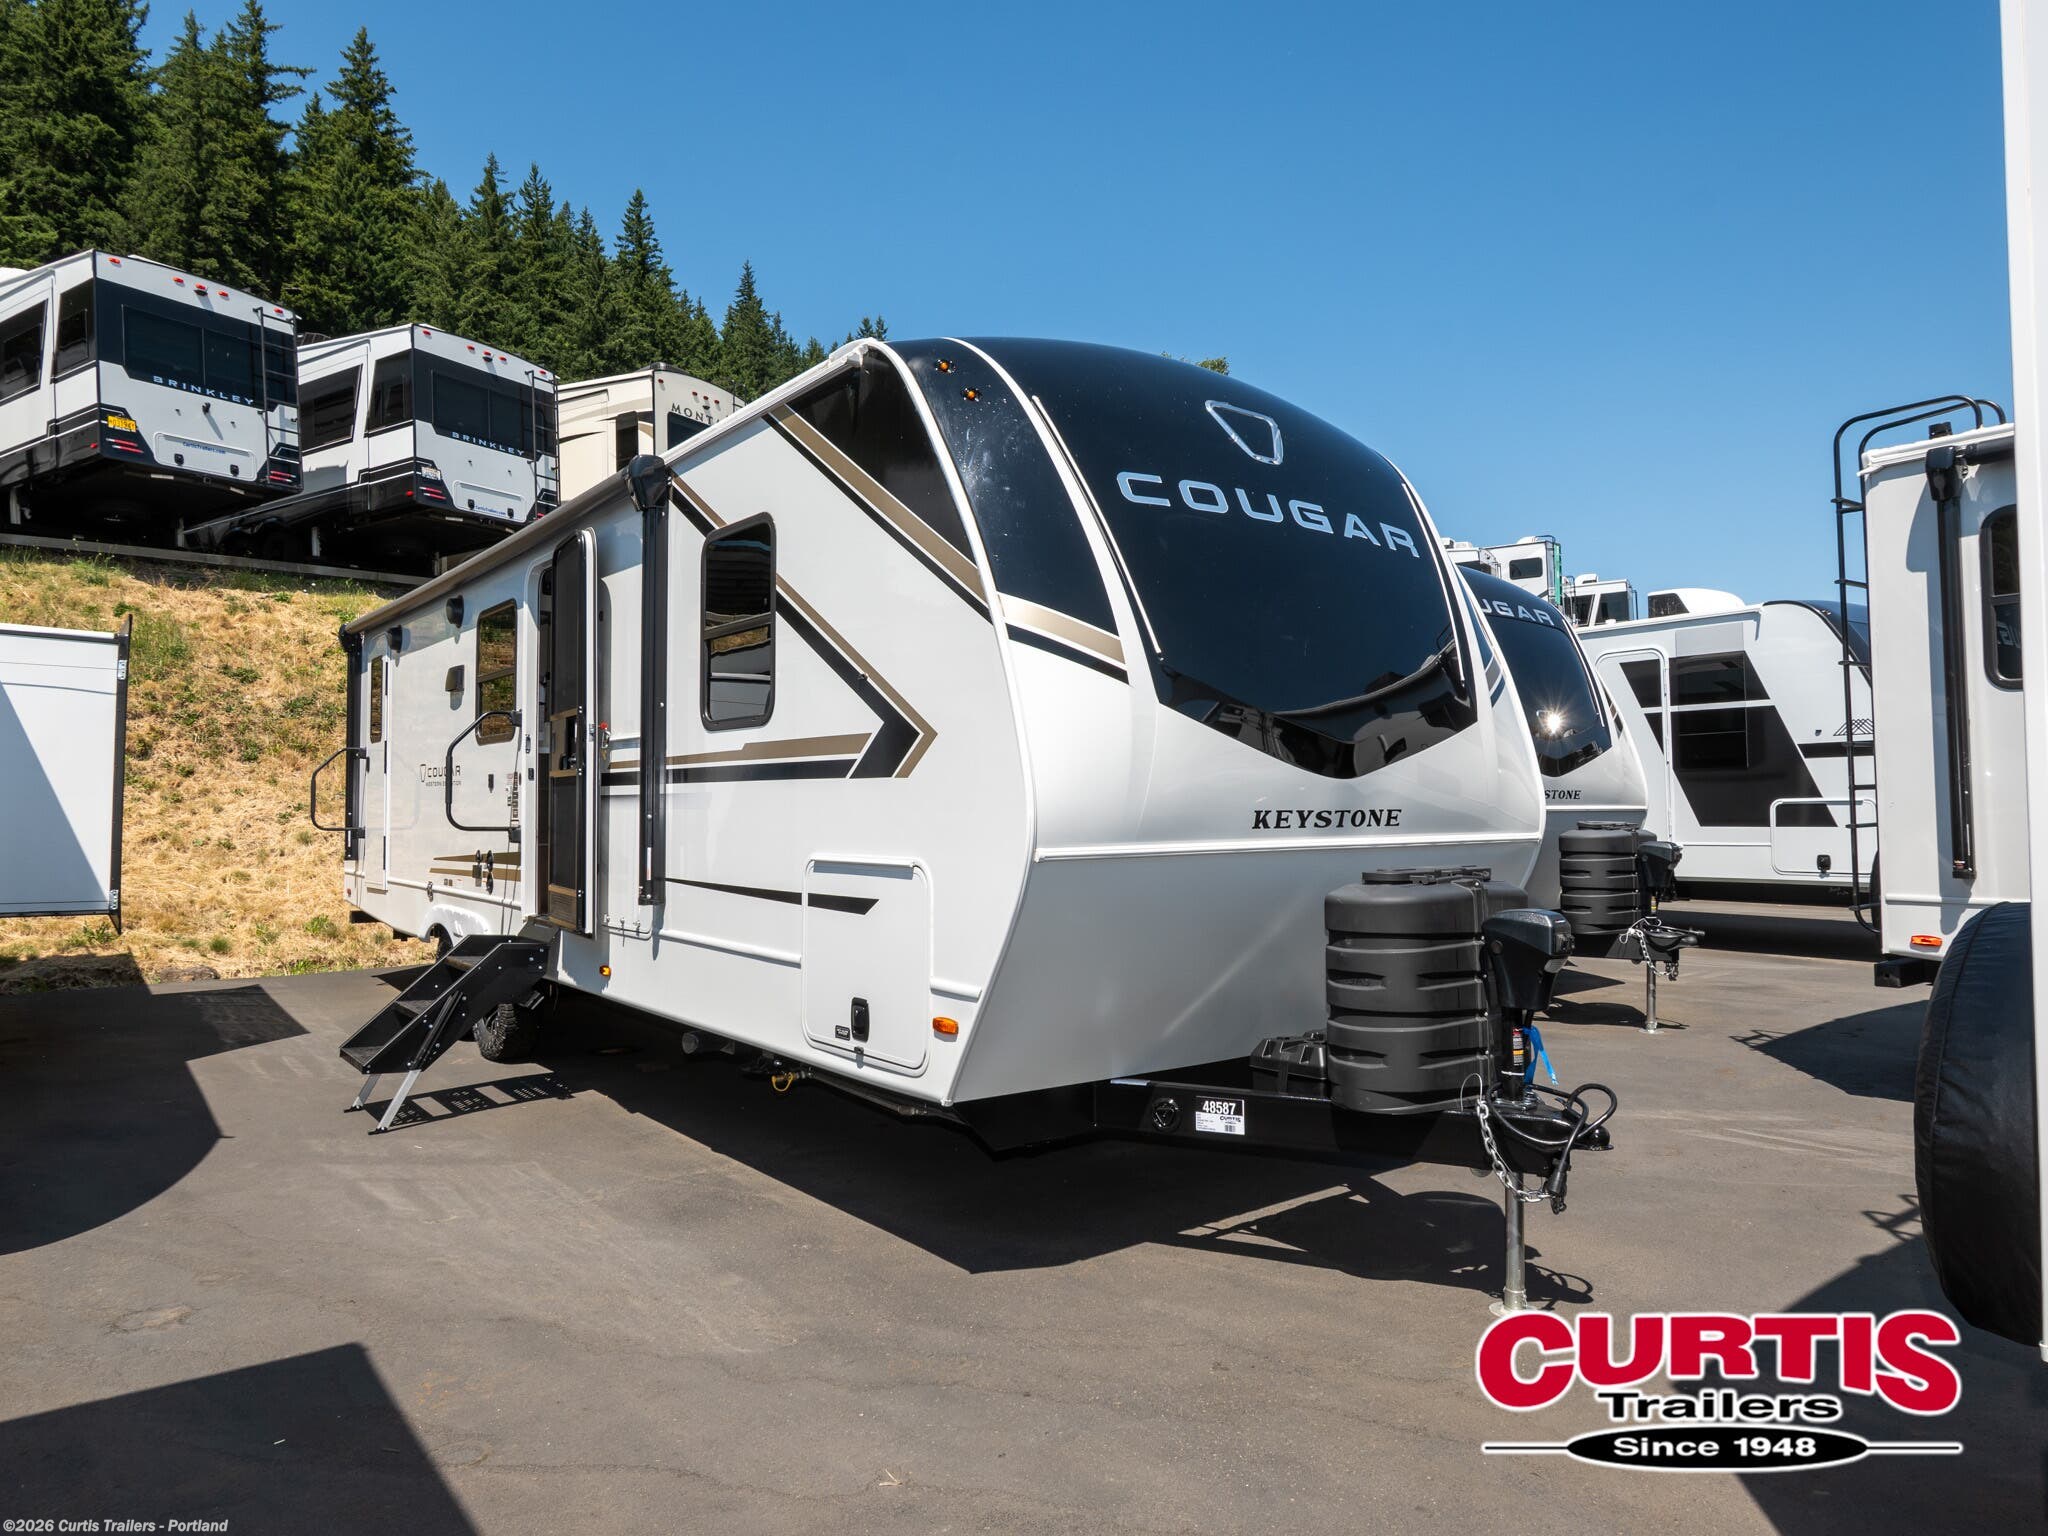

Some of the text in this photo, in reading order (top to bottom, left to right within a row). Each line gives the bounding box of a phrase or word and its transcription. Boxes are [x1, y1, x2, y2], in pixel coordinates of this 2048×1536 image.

[153, 375, 254, 405] BRINKLEY
[671, 402, 720, 425] MONT
[452, 431, 525, 456] BRINKLEY
[1116, 471, 1420, 559] COUGAR
[1481, 598, 1555, 627] UGAR
[427, 765, 461, 778] COUR
[1544, 789, 1582, 800] STONE
[1251, 808, 1402, 830] KEYSTONE
[1202, 1100, 1236, 1115] 48587
